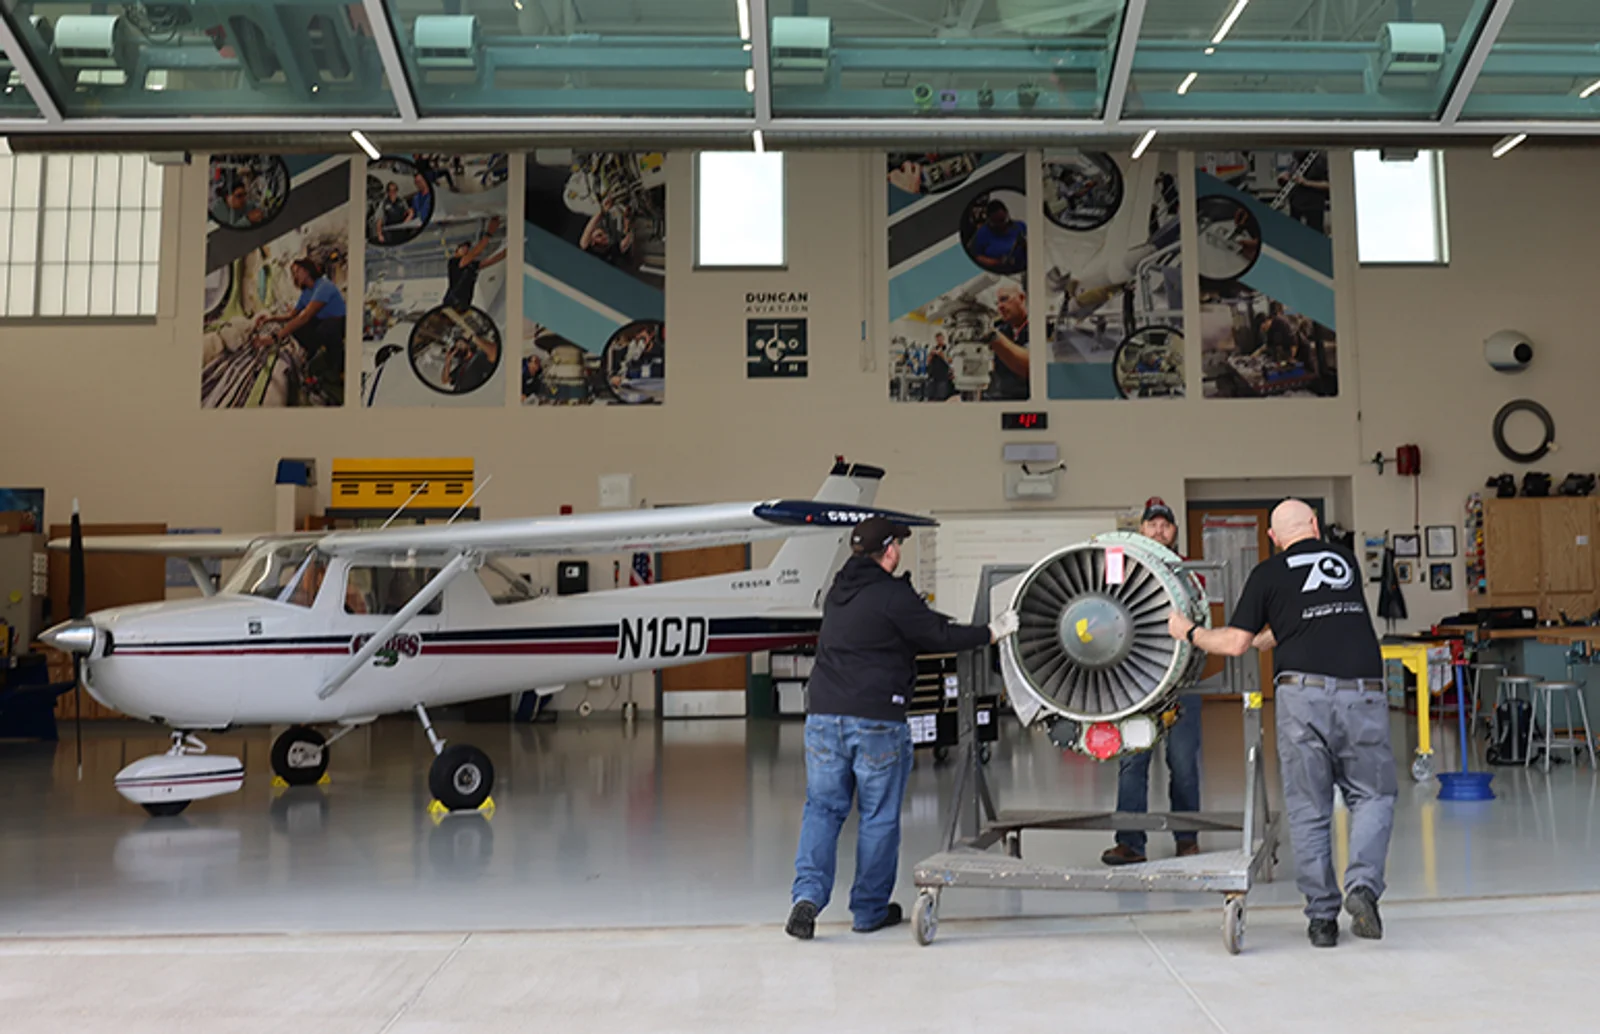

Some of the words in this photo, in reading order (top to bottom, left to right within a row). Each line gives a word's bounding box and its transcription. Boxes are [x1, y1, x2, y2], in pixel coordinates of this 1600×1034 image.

[745, 292, 808, 303] DUNCAN
[745, 305, 808, 313] AVIATION
[1286, 551, 1353, 593] 70
[619, 616, 706, 659] N1CD
